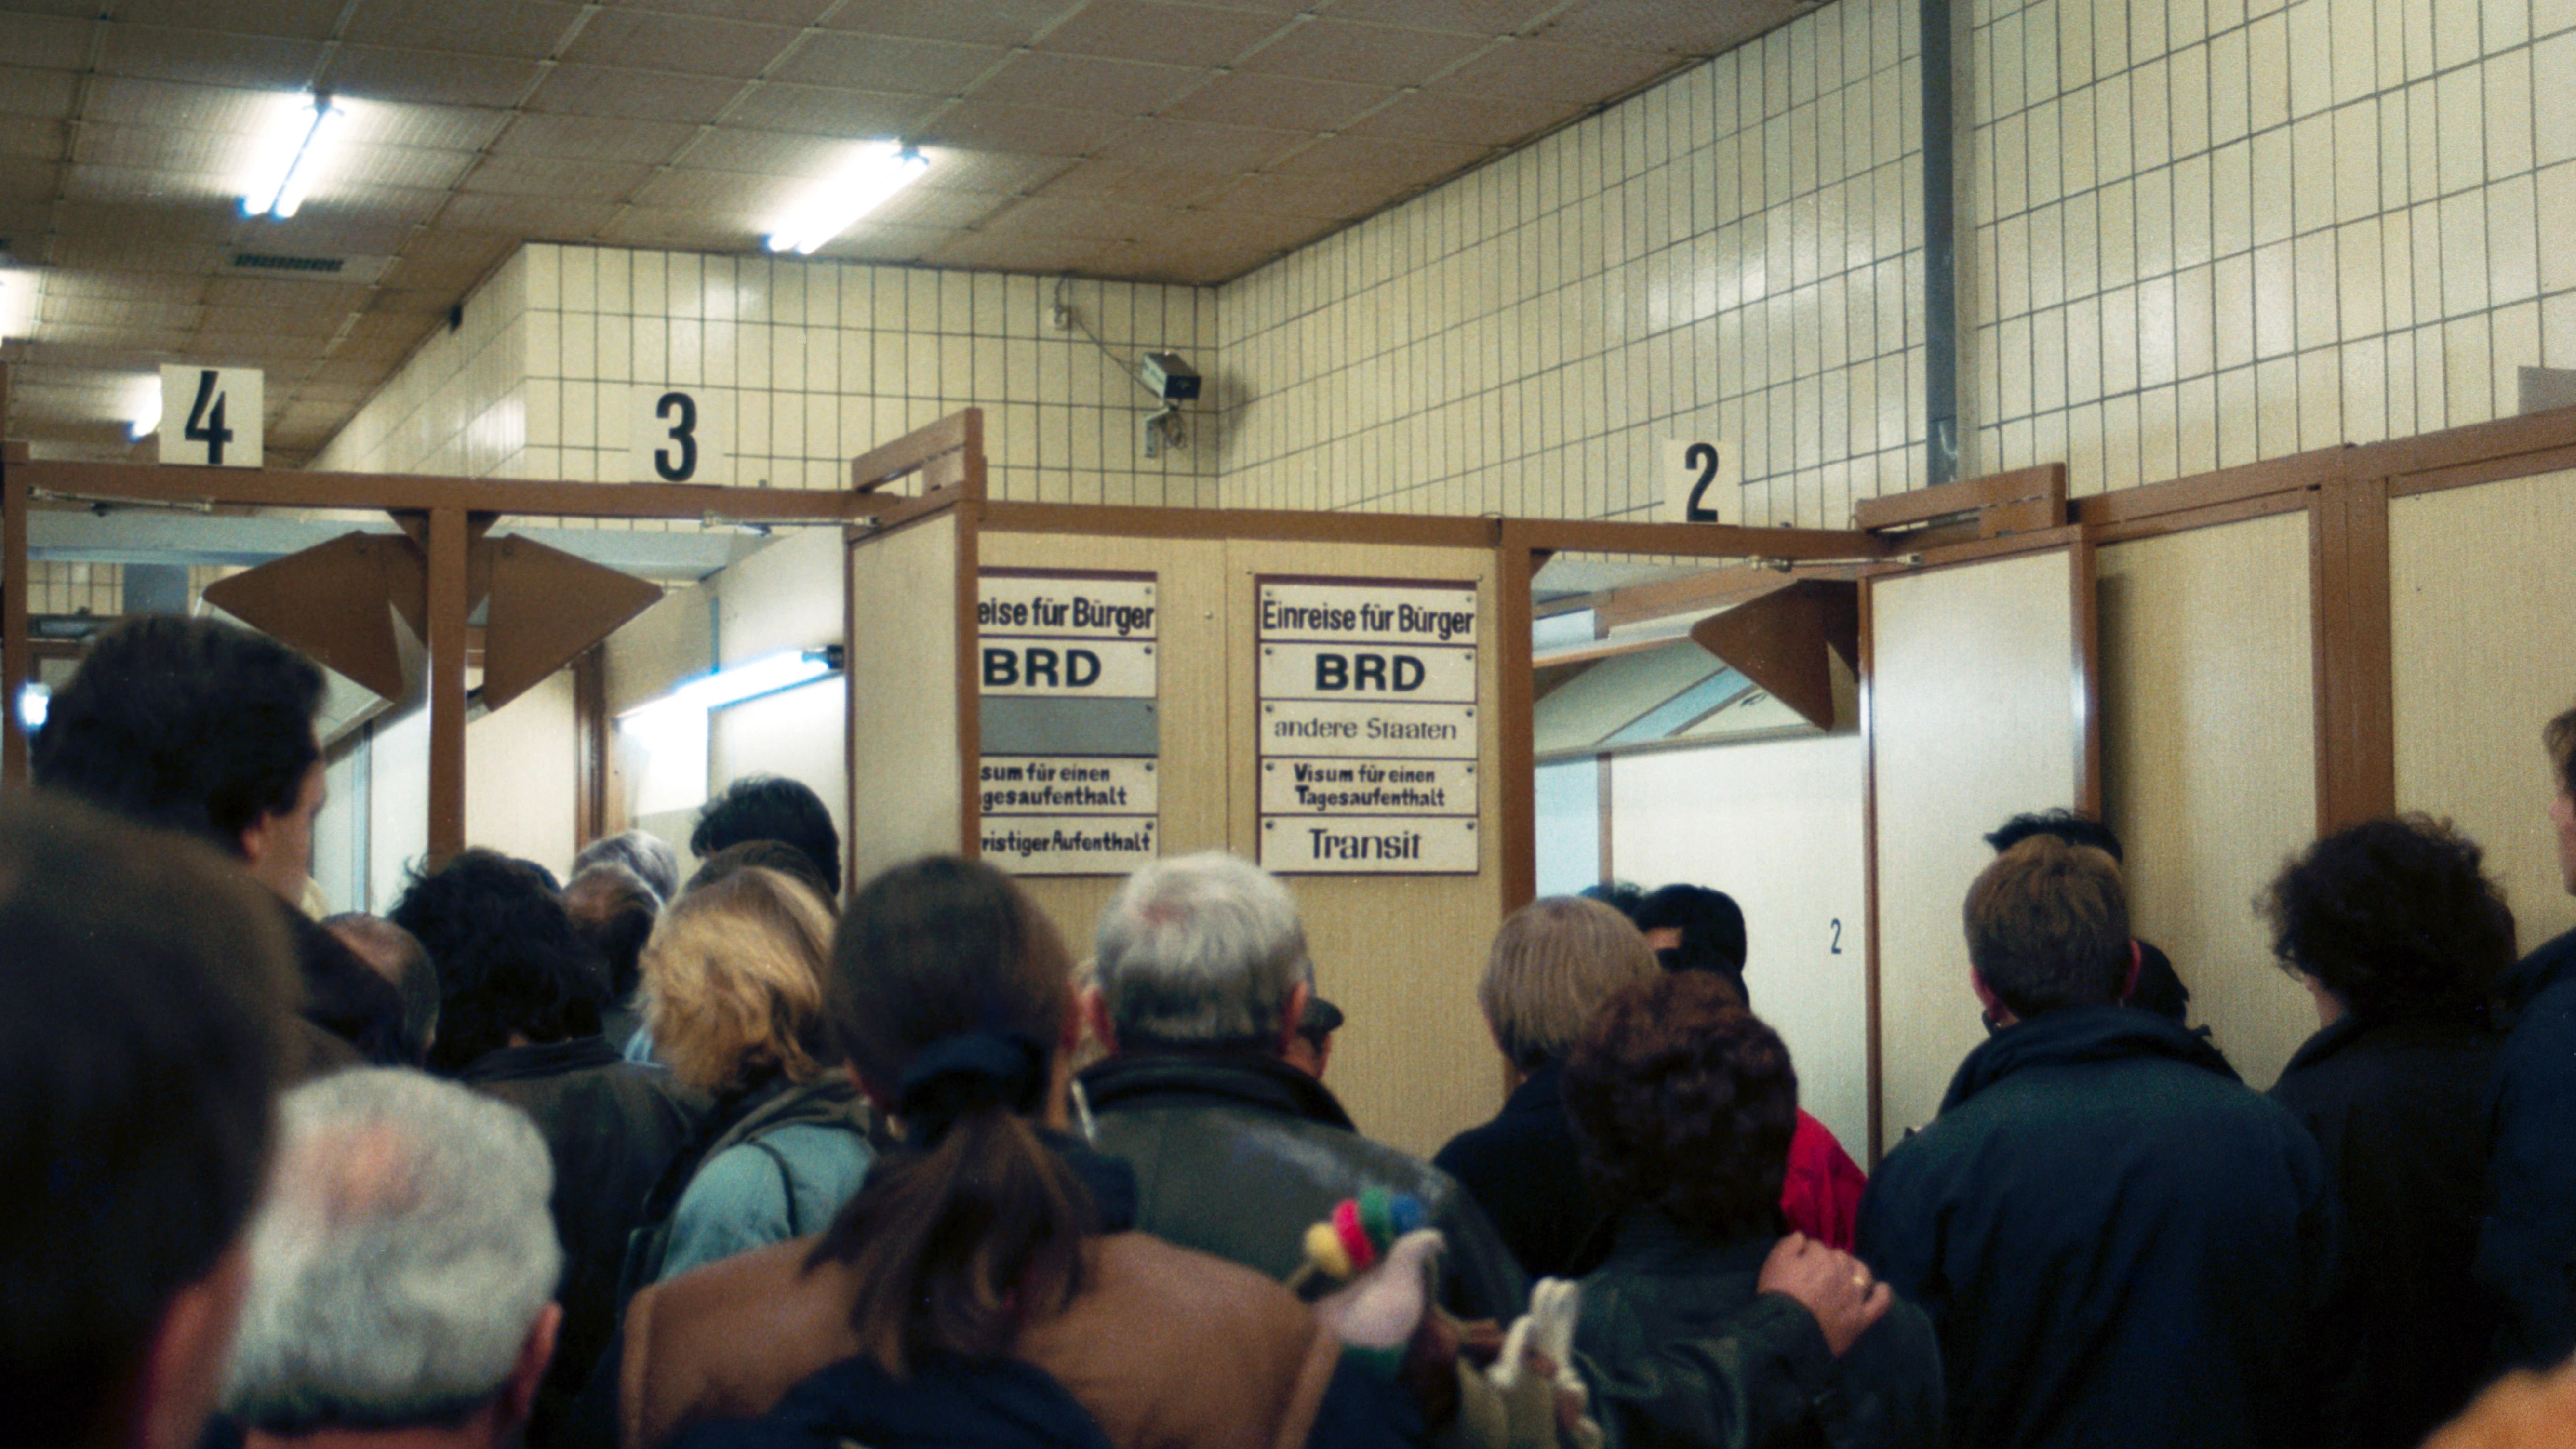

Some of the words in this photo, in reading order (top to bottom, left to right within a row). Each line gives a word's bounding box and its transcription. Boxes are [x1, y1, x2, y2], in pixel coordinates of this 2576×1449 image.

[185, 370, 233, 465] 4
[654, 392, 697, 481] 3
[1685, 442, 1718, 522] 2
[978, 597, 1027, 626] eise
[1032, 597, 1068, 626] für
[1073, 597, 1154, 635] Bürger
[1262, 600, 1355, 631] Einreise
[1360, 603, 1394, 631] für
[1399, 603, 1475, 640] Bürger
[983, 648, 1101, 687] BRD
[1316, 654, 1425, 691] BRD
[1274, 718, 1358, 738] andere
[1367, 718, 1457, 740] Staaten
[980, 765, 1023, 781] sum
[1027, 763, 1057, 782] für
[1060, 764, 1110, 782] einen
[1294, 763, 1353, 782] Visum
[1358, 764, 1385, 783] für
[1389, 766, 1435, 783] einen
[982, 785, 1127, 811] gesaufenthalt
[1295, 785, 1444, 811] Tagesaufenthalt
[981, 830, 1050, 857] ristiger
[1052, 830, 1151, 851] Aufenthalt
[1309, 829, 1421, 859] Transit
[1831, 918, 1841, 954] 2
